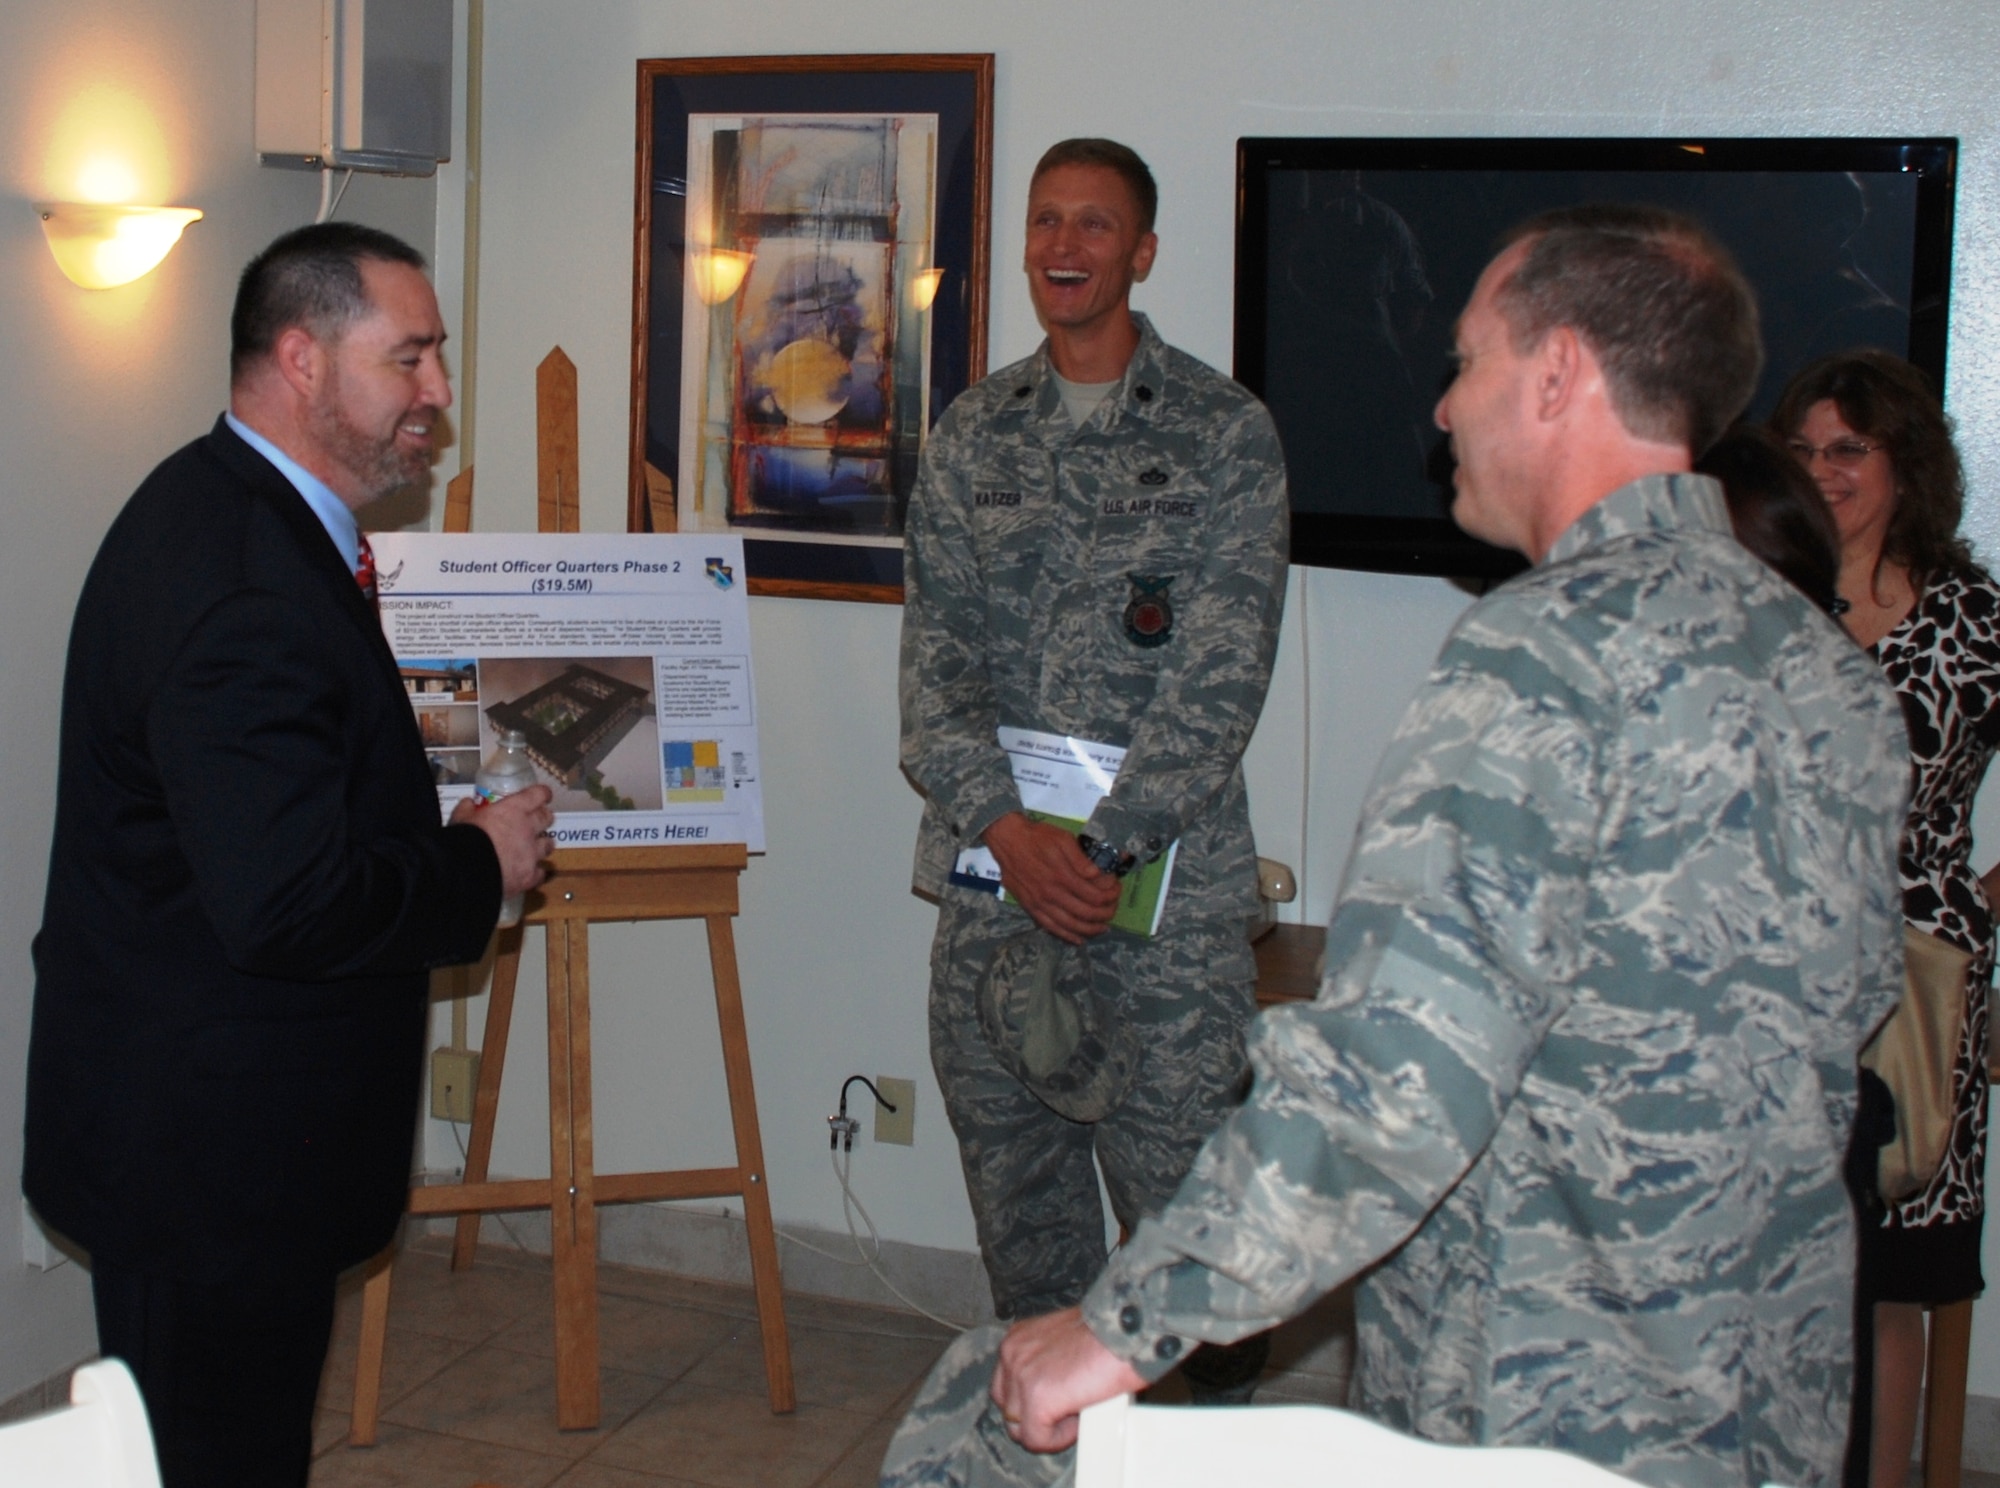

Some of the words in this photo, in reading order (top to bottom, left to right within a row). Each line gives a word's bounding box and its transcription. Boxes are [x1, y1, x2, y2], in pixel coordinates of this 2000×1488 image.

[1103, 500, 1126, 514] U.S.
[1129, 500, 1151, 514] AIR
[1154, 501, 1197, 517] FORCE
[439, 560, 498, 573] Student
[502, 560, 552, 573] Officer
[556, 560, 619, 574] Quarters
[623, 560, 668, 573] Phase
[672, 561, 681, 573] 2
[531, 579, 593, 594] ($19.5M)
[379, 601, 413, 610] ISSION
[415, 600, 454, 610] IMPACT:
[604, 826, 659, 841] STARTS
[664, 824, 709, 839] HERE!
